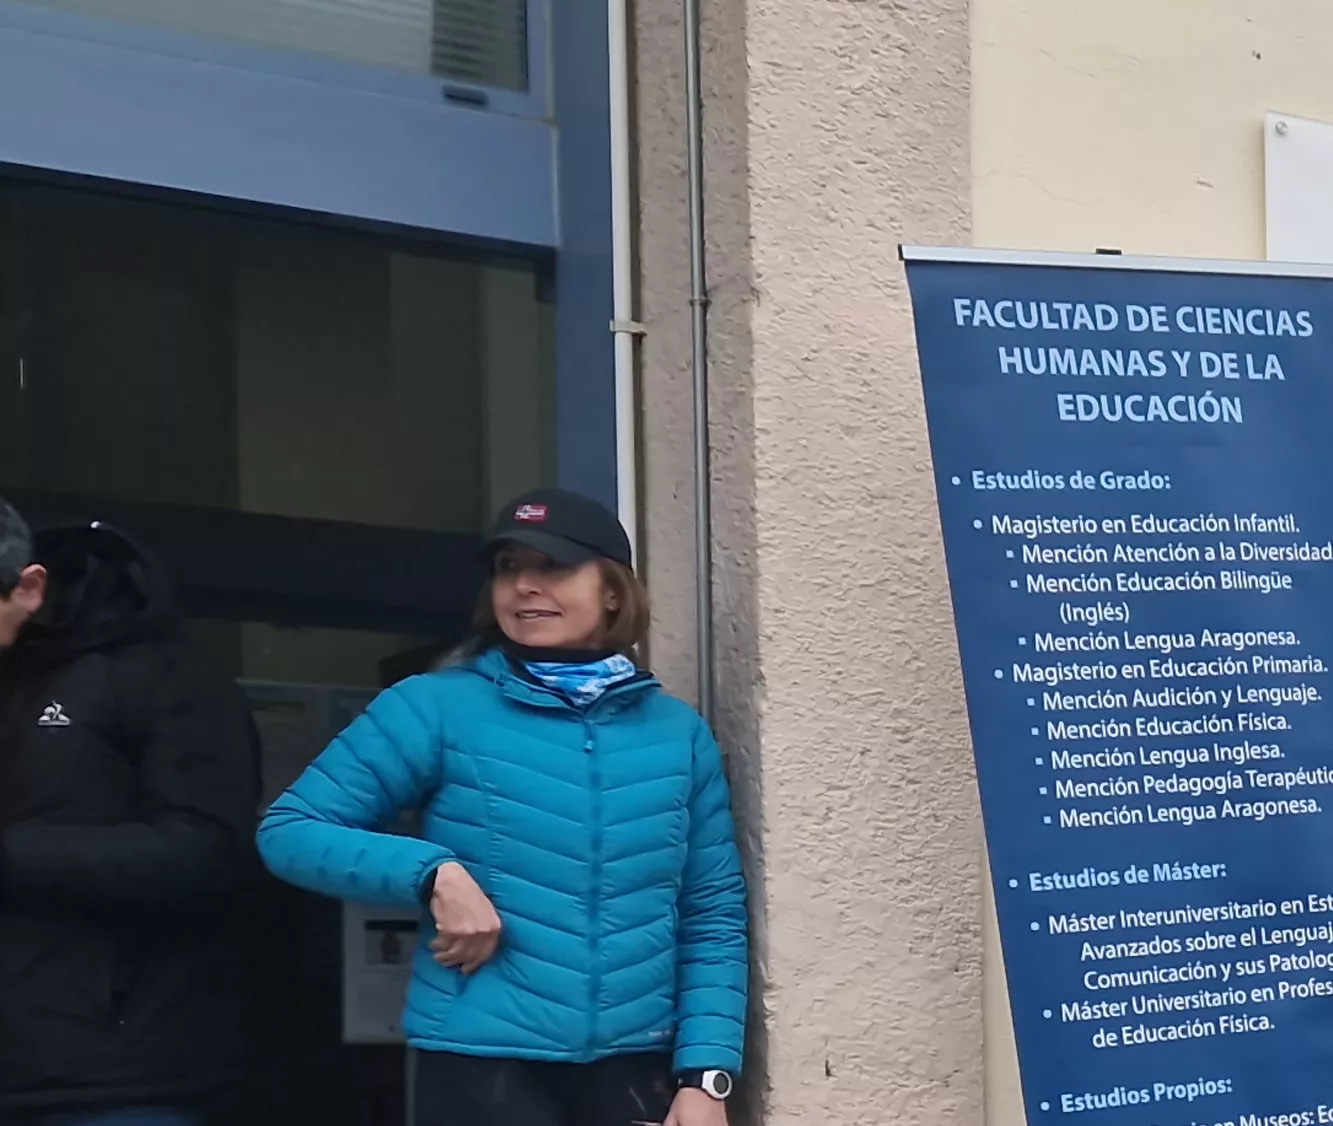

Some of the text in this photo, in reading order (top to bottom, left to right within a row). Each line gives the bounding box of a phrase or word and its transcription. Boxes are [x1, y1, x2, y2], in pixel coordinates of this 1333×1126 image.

[954, 299, 1313, 336] FACULTAD DE CIENCIAS
[999, 347, 1285, 380] HUMANAS Y DE LA
[1058, 391, 1242, 423] EDUCACIÓN
[972, 470, 1170, 489] Estudios de Grado:
[993, 513, 1299, 538] Magisterio en Educación Infantil.
[1023, 544, 1108, 563] Mención
[1114, 543, 1199, 562] Atención
[1205, 547, 1215, 561] a
[1220, 542, 1236, 560] la
[1027, 570, 1292, 593] Mención Educación Bilingüe
[1060, 602, 1129, 626] (Inglés)
[1035, 629, 1300, 653] Mención Lengua Aragonesa.
[1013, 655, 1328, 686] Magisterio en Educación Primaria.
[1044, 683, 1321, 710] Mención Audición y Lenguaje.
[1048, 713, 1291, 740] Mención Educación Física.
[1052, 741, 1284, 769] Mención Lengua Inglesa.
[1056, 777, 1139, 798] Mención
[1144, 771, 1243, 796] Pedagogía
[1060, 799, 1321, 828] Mención Lengua Aragonesa.
[1030, 862, 1226, 891] Estudios de Máster:
[1049, 914, 1115, 934] Máster
[1120, 899, 1276, 929] Interuniversitario
[1281, 900, 1303, 914] en
[1081, 935, 1181, 961] Avanzados
[1186, 931, 1236, 951] sobre
[1241, 927, 1256, 946] el
[1084, 961, 1216, 989] Comunicación
[1220, 963, 1231, 982] y
[1236, 960, 1265, 975] sus
[1062, 1001, 1128, 1022] Máster
[1132, 987, 1247, 1017] Universitario
[1251, 988, 1274, 1002] en
[1093, 1014, 1275, 1048] de Educación Física.
[1061, 1078, 1232, 1112] Estudios Propios:
